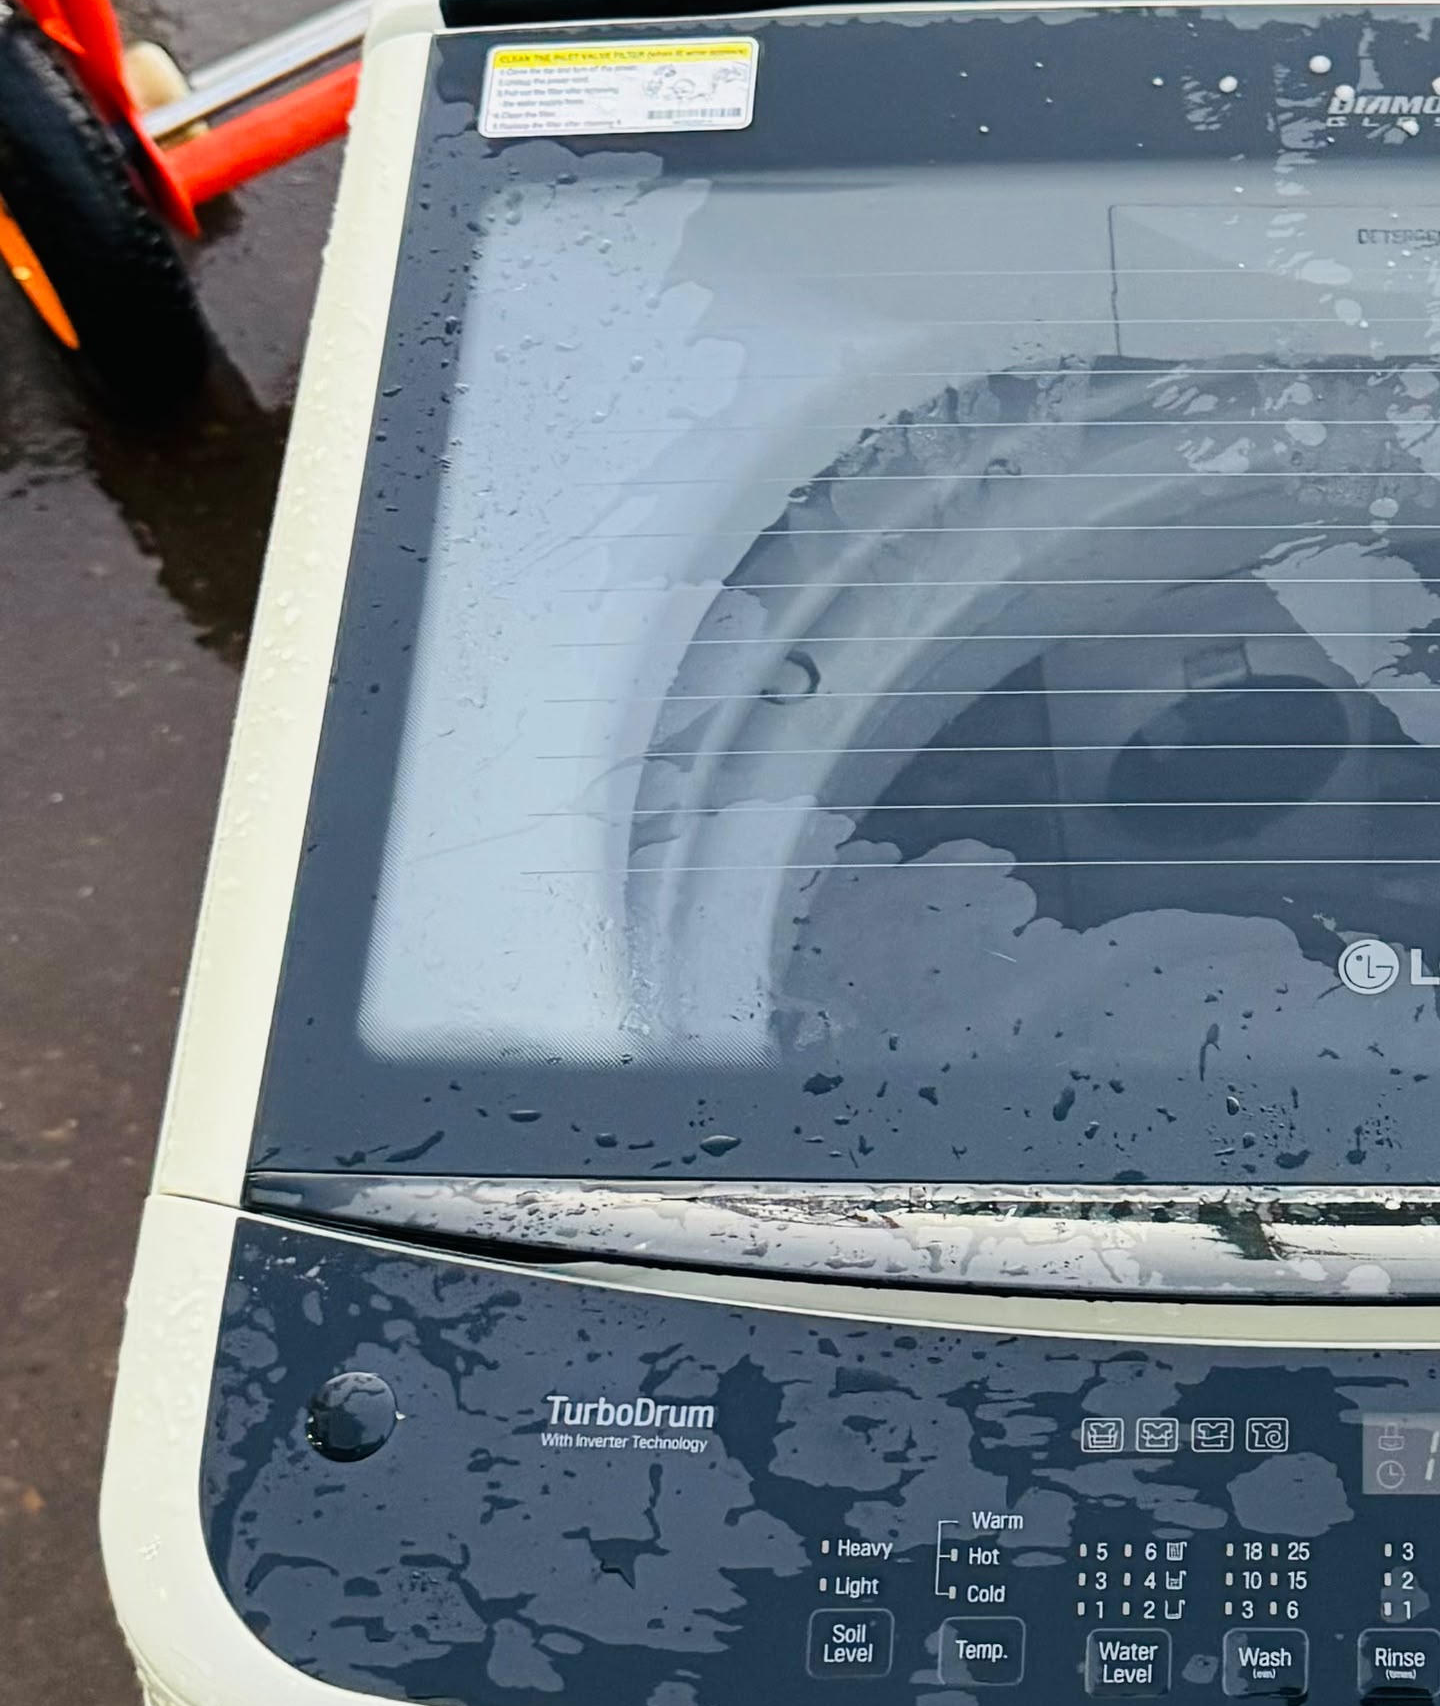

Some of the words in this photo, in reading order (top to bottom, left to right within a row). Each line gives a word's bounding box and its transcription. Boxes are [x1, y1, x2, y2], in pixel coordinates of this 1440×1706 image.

[546, 1395, 716, 1429] TurboDrum
[541, 1433, 573, 1448] With
[575, 1434, 629, 1449] Inverter
[632, 1435, 708, 1453] Technology
[972, 1512, 1024, 1531] Warm
[837, 1539, 893, 1560] Heavy
[968, 1548, 1000, 1566] Hot
[1096, 1542, 1108, 1561] 5
[1145, 1542, 1158, 1561] 6
[1243, 1542, 1263, 1561] 18
[1287, 1542, 1310, 1561] 25
[1401, 1542, 1414, 1561] 3
[834, 1577, 880, 1598] Light
[1095, 1571, 1107, 1590] 3
[1144, 1571, 1157, 1590] 4
[1242, 1571, 1262, 1590] 10
[1287, 1571, 1308, 1590] 15
[1401, 1571, 1414, 1590] 2
[967, 1585, 1006, 1603] Cold
[1095, 1600, 1105, 1619] 1
[1143, 1600, 1156, 1620] 2
[1241, 1600, 1254, 1619] 3
[1286, 1600, 1299, 1619] 6
[1402, 1601, 1412, 1620] 1
[832, 1624, 867, 1644] Soil
[823, 1643, 873, 1663] Level
[955, 1640, 1009, 1662] Temp.
[1099, 1641, 1159, 1662] Water
[1238, 1647, 1292, 1668] Wash
[1375, 1647, 1426, 1668] Rinse
[1103, 1664, 1153, 1684] Level
